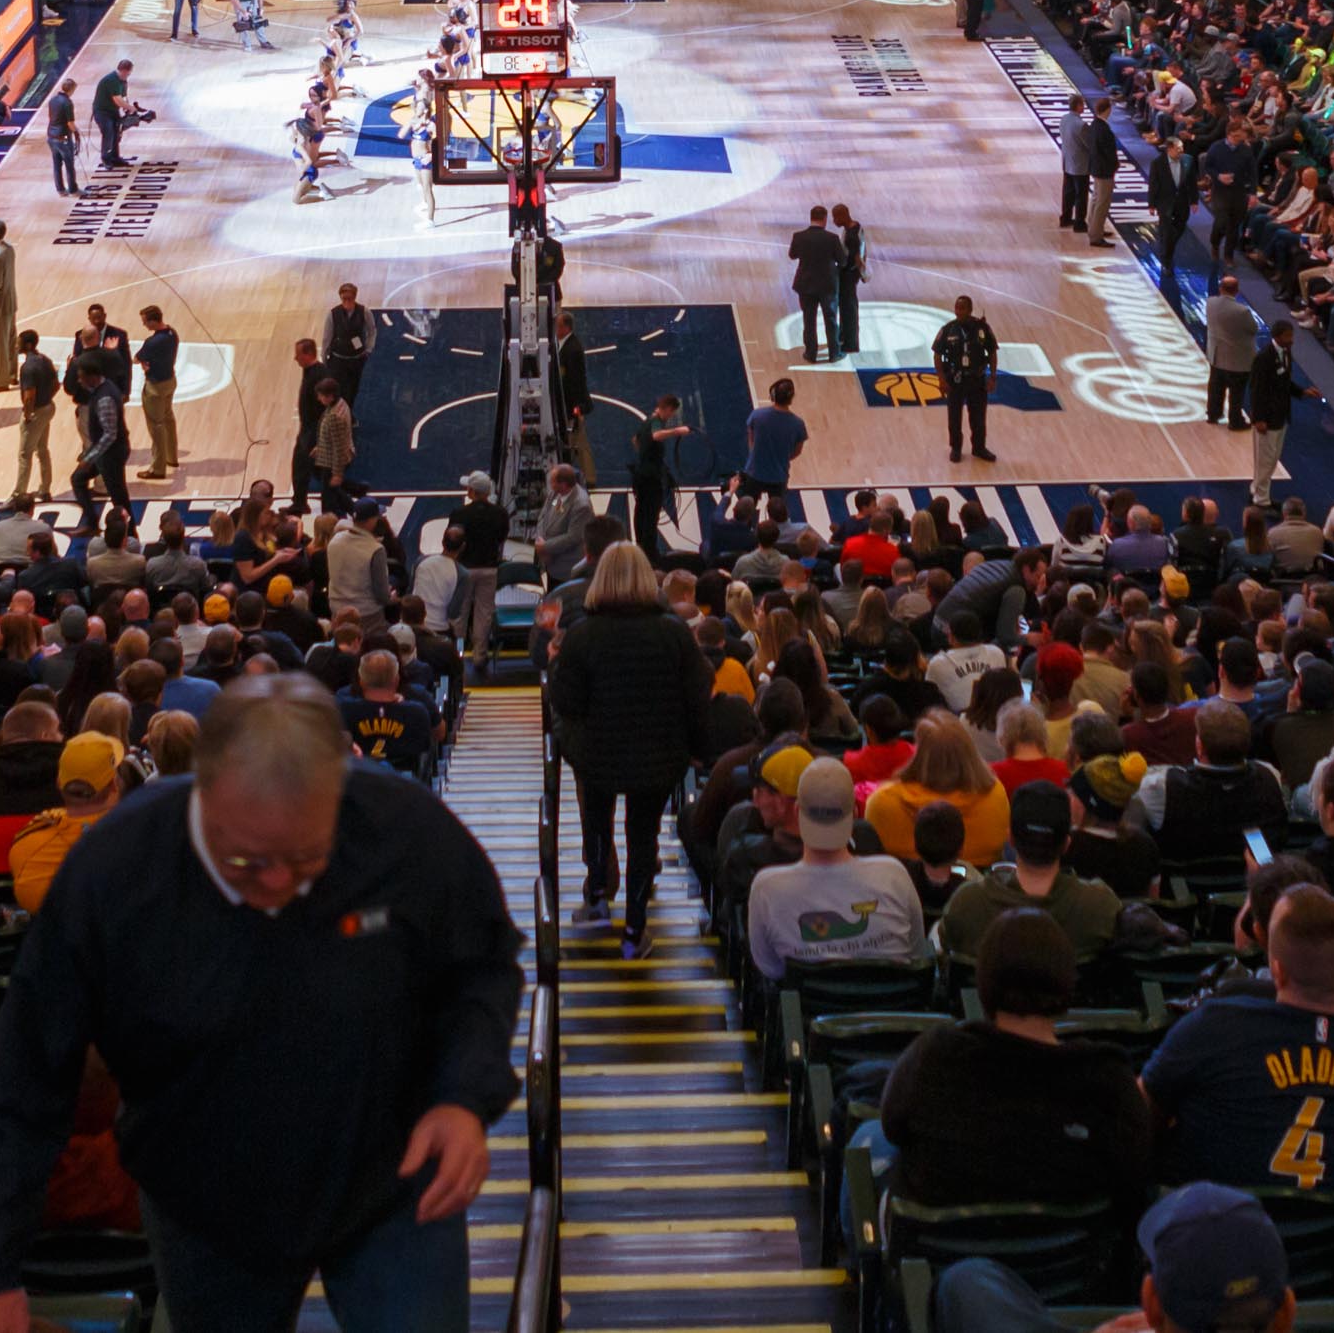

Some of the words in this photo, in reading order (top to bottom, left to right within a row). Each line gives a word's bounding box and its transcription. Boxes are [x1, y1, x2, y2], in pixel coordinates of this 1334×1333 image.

[507, 35, 561, 47] TISSOT
[831, 35, 869, 52] LIFE
[52, 184, 124, 245] BANKERS
[104, 161, 180, 238] FIELDHOUSE
[358, 717, 405, 739] OLADIPO
[1269, 1096, 1325, 1189] 4
